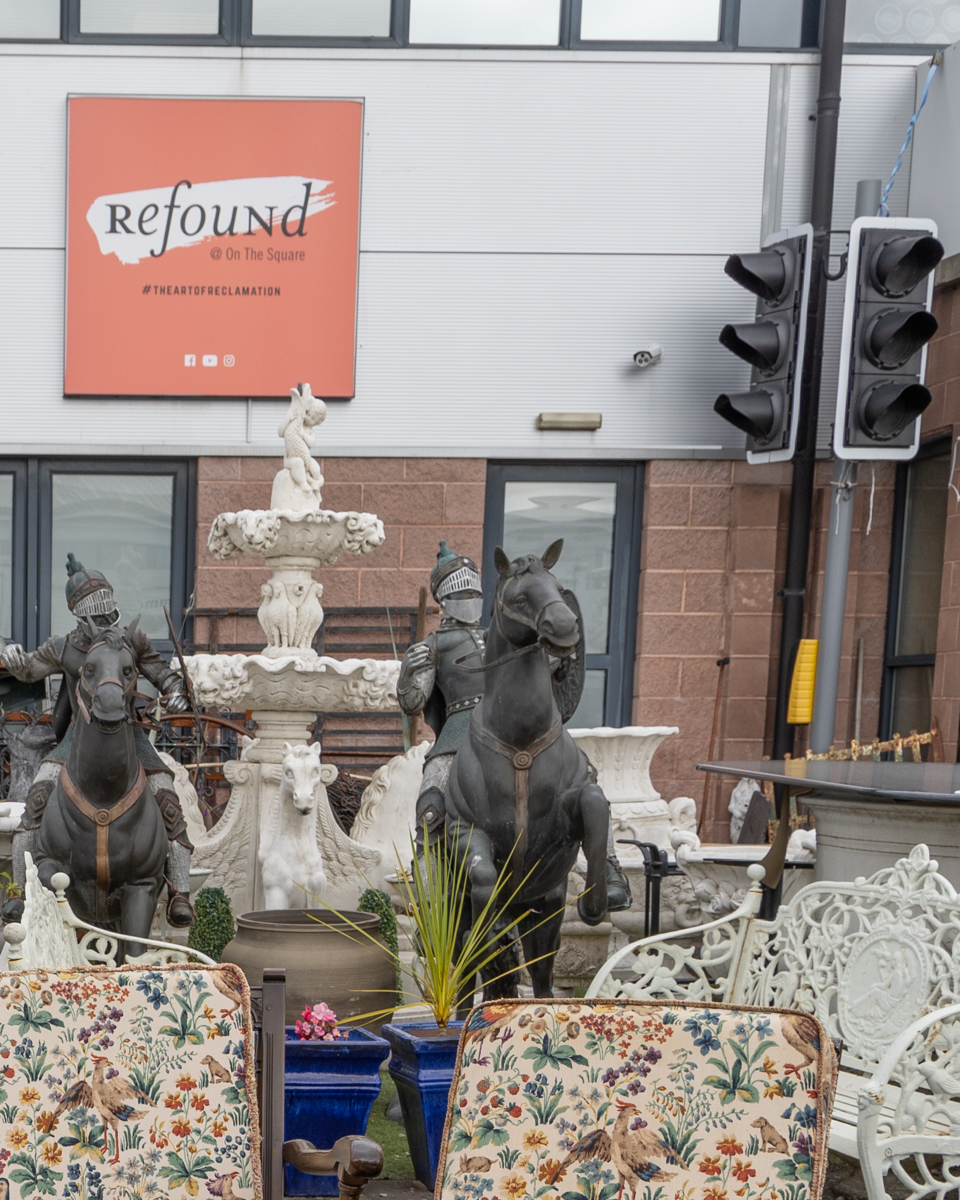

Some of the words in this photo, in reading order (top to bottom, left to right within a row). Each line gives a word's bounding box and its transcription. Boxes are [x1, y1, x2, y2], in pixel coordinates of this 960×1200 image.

[210, 247, 222, 260] @
[226, 248, 241, 261] On
[244, 248, 263, 261] The
[267, 248, 305, 263] Square
[142, 284, 281, 296] #THEARTOFRECLAMATION
